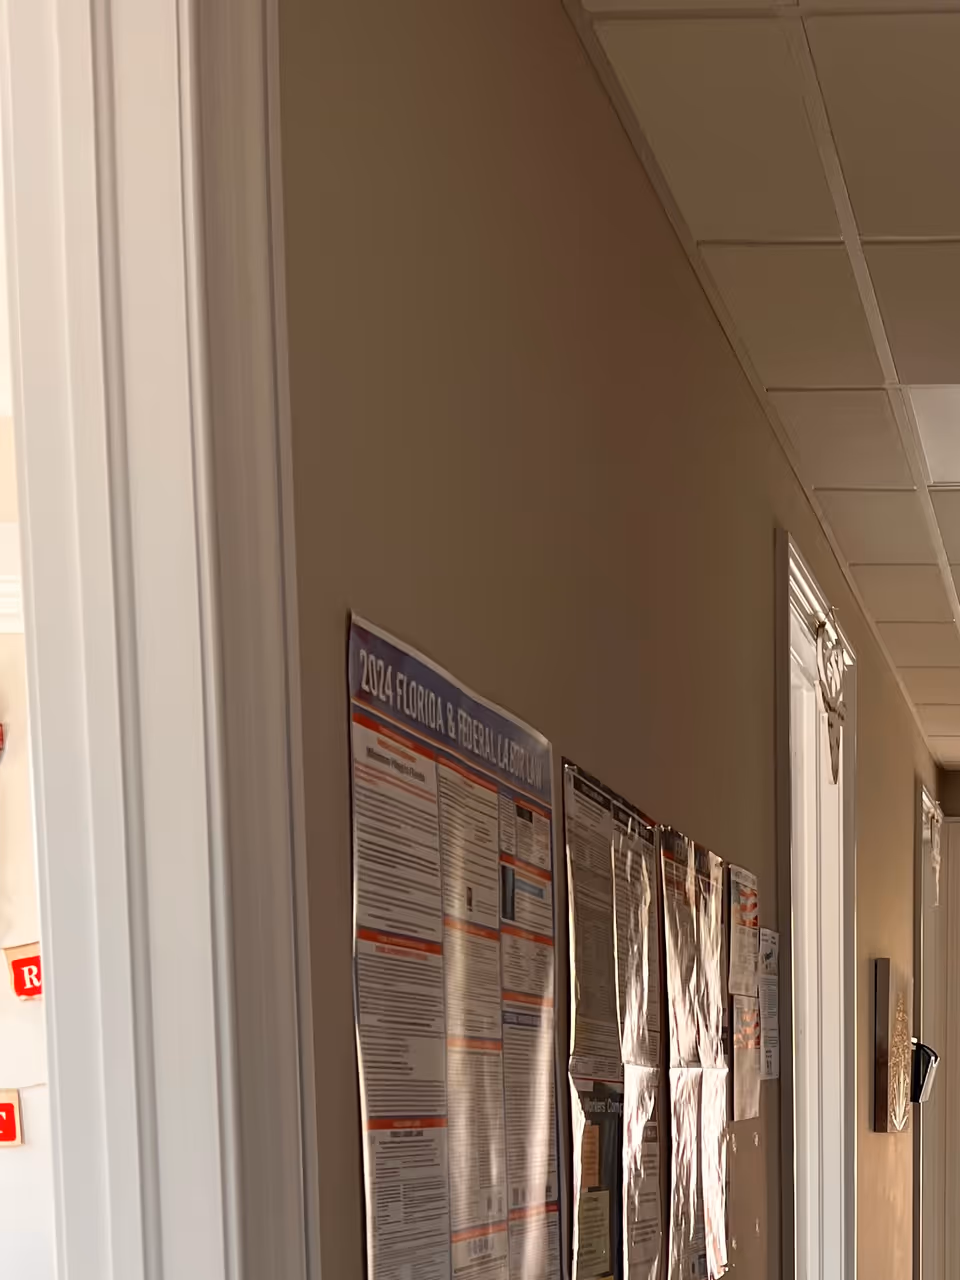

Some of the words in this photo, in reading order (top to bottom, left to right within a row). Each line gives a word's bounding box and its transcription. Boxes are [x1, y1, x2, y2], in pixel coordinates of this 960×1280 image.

[360, 649, 393, 706] 2024
[396, 672, 445, 735] FLORIDA
[447, 702, 456, 739] &
[457, 706, 497, 765] FEDERAL
[498, 733, 525, 780] LABOR
